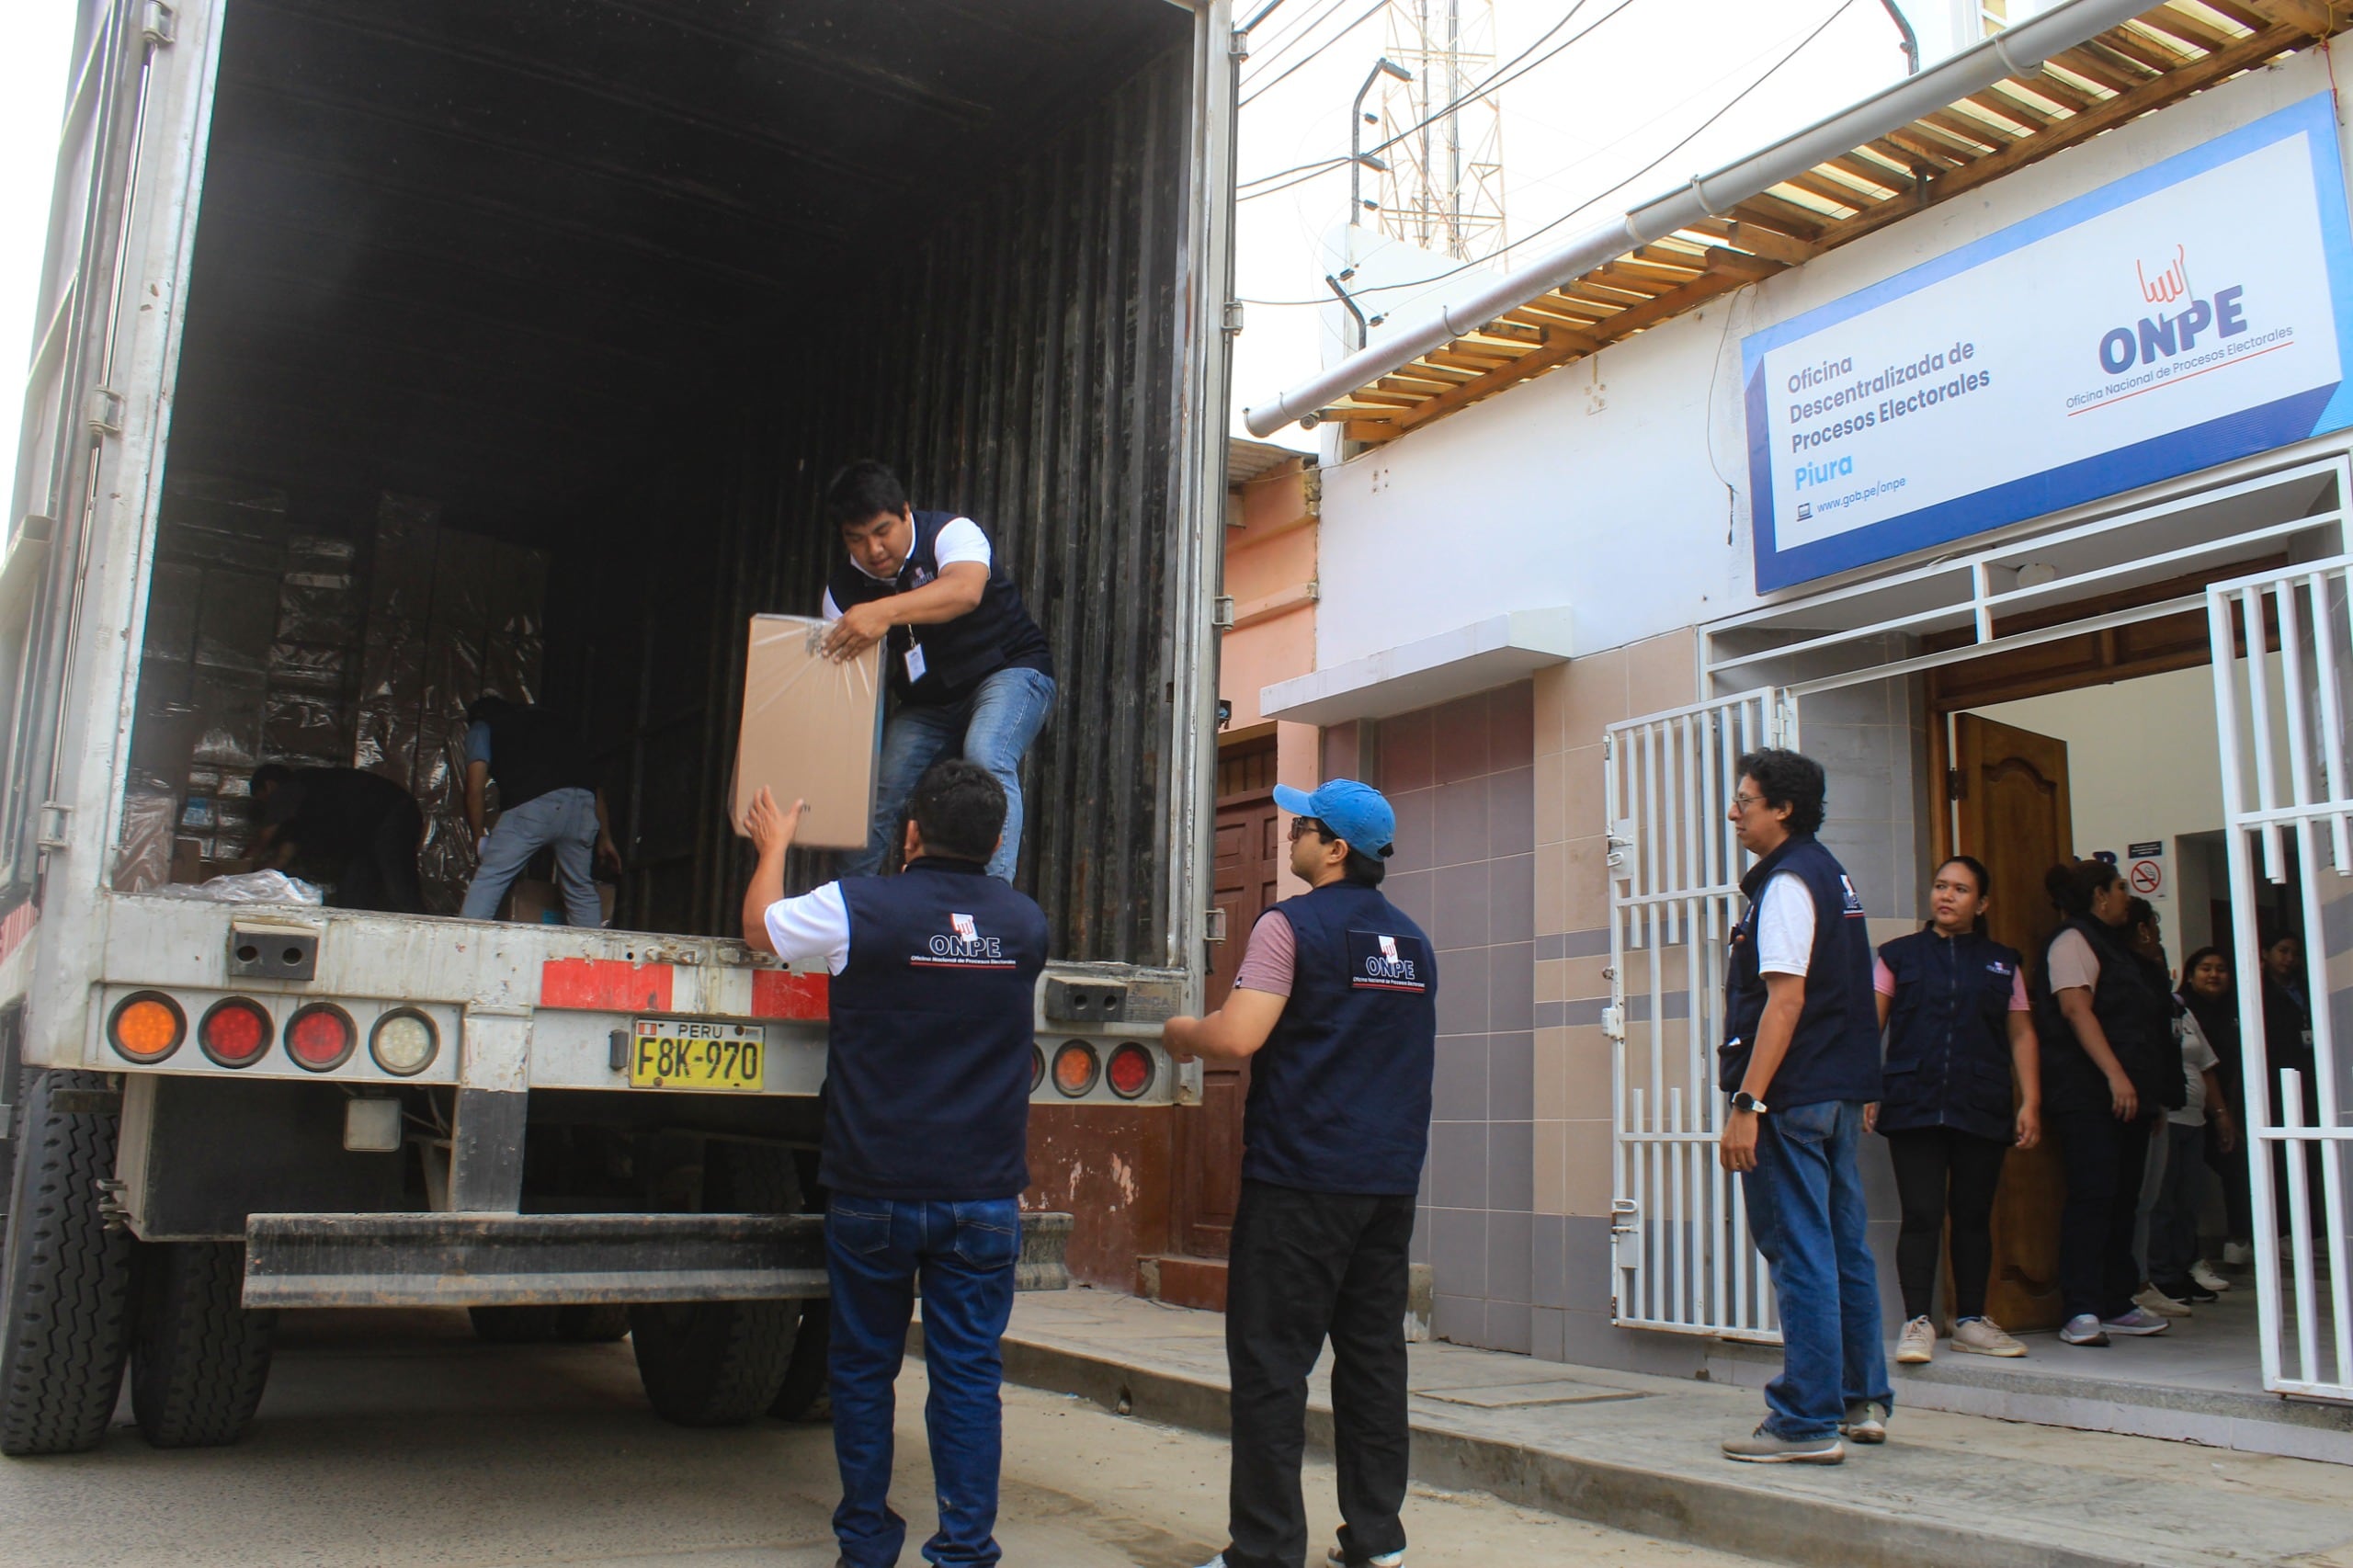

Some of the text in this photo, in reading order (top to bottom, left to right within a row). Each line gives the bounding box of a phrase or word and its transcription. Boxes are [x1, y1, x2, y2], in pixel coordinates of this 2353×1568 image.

[2098, 284, 2248, 375] ONPE
[1788, 357, 1852, 393] Oficina
[1790, 341, 1975, 424] Descentralizada de
[2065, 325, 2294, 409] Oficina Nacional de Procesos Electorales
[1791, 369, 1991, 454] Procesos Electorales
[1794, 455, 1853, 491] Piura
[1816, 476, 1907, 513] www.gob.pe/onpe
[929, 935, 1002, 958] ONPE
[1365, 956, 1415, 980] ONPE
[678, 1024, 723, 1039] PERU
[638, 1037, 758, 1080] F8K-970
